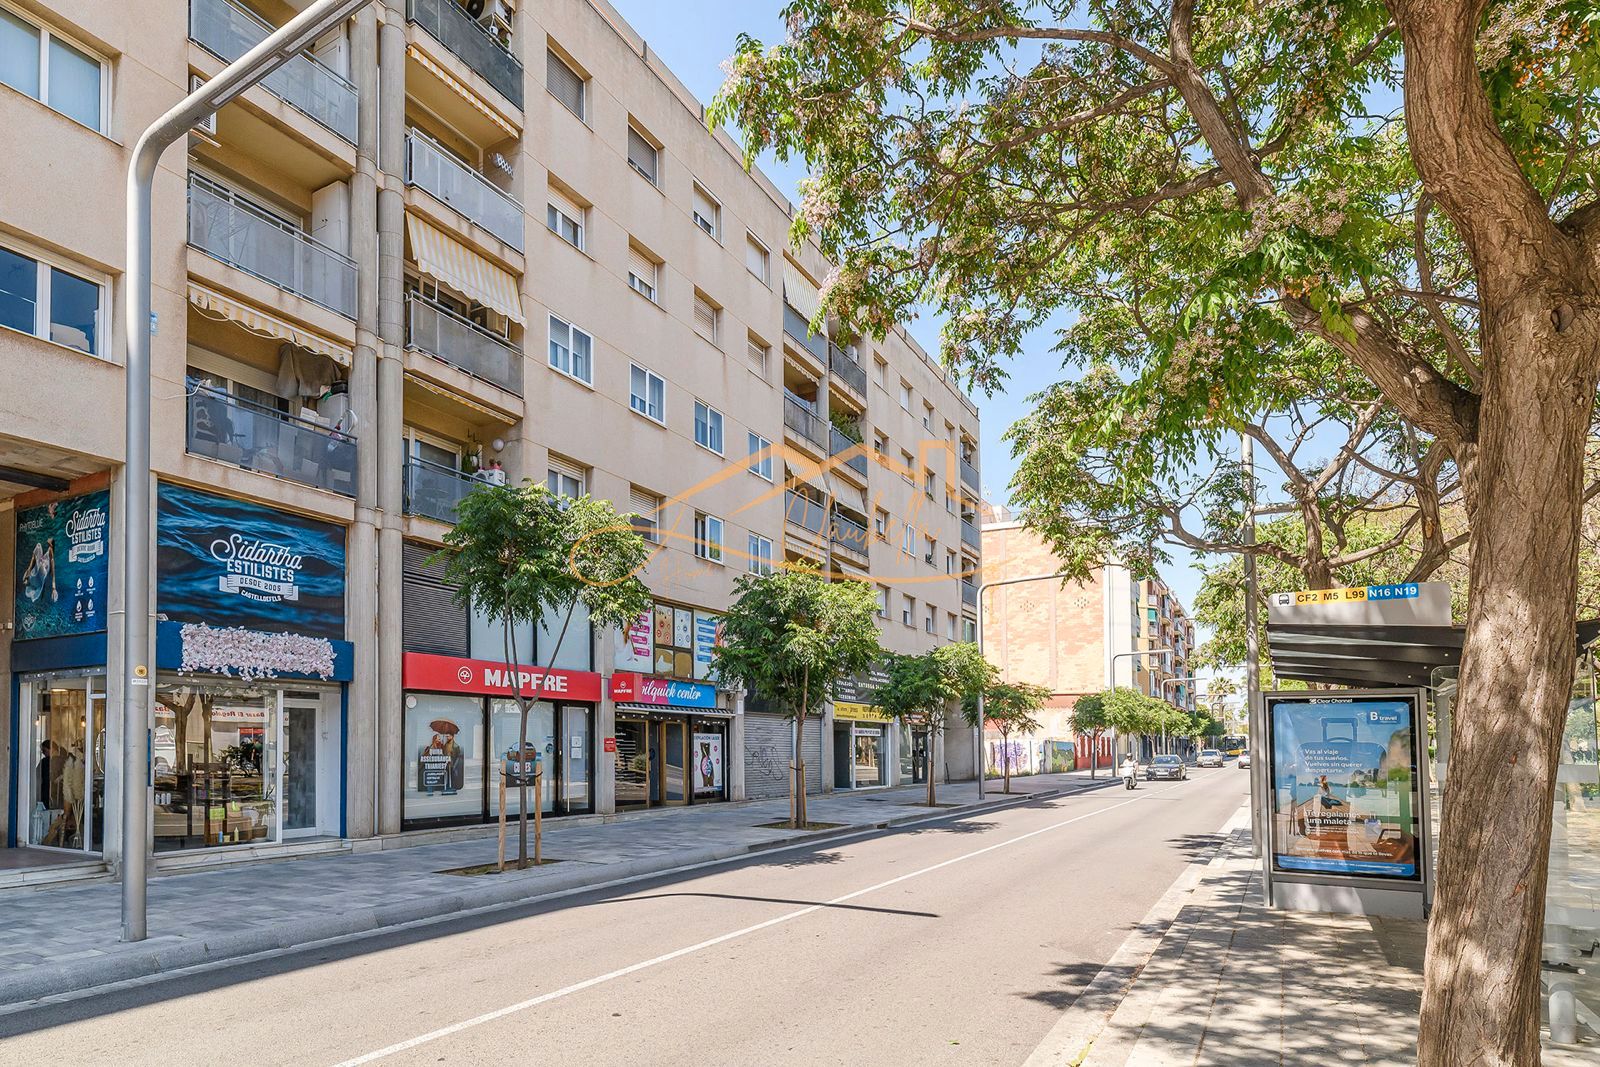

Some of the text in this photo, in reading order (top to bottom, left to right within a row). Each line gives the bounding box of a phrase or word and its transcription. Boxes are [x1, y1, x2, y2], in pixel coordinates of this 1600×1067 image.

[65, 508, 106, 537] Sidartha
[71, 528, 102, 544] ESTILISTES
[210, 533, 303, 570] Sidartha
[226, 559, 294, 582] ESTILISTES
[239, 577, 262, 588] DESDE
[1297, 586, 1417, 602] CF2 M5 L99 N16 N19
[484, 668, 568, 692] MAPFRE
[677, 685, 701, 700] center
[1369, 711, 1378, 721] B
[1318, 811, 1361, 819] regalamos
